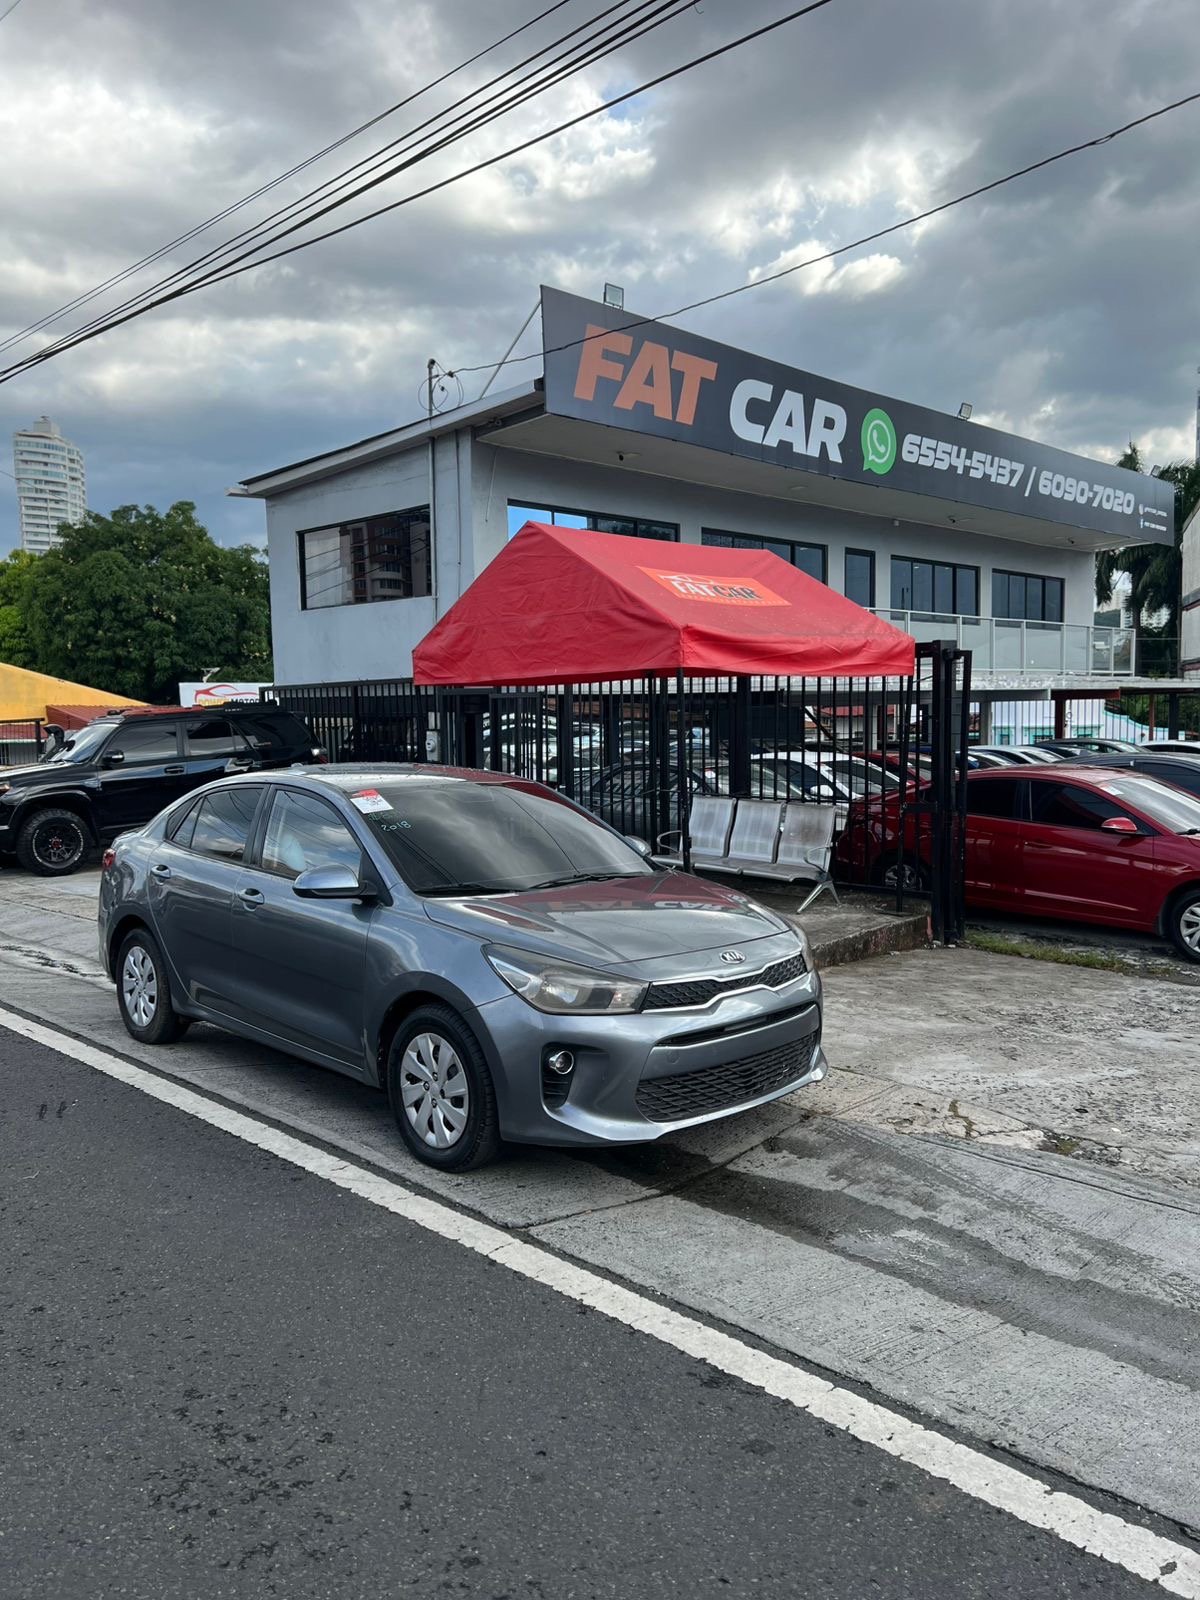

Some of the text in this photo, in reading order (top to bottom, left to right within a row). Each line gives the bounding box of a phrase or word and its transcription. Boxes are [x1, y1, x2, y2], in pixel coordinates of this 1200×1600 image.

[573, 323, 847, 464] FAT CAR
[901, 433, 1025, 488] 6554-5437
[1038, 470, 1136, 515] 6090-7020
